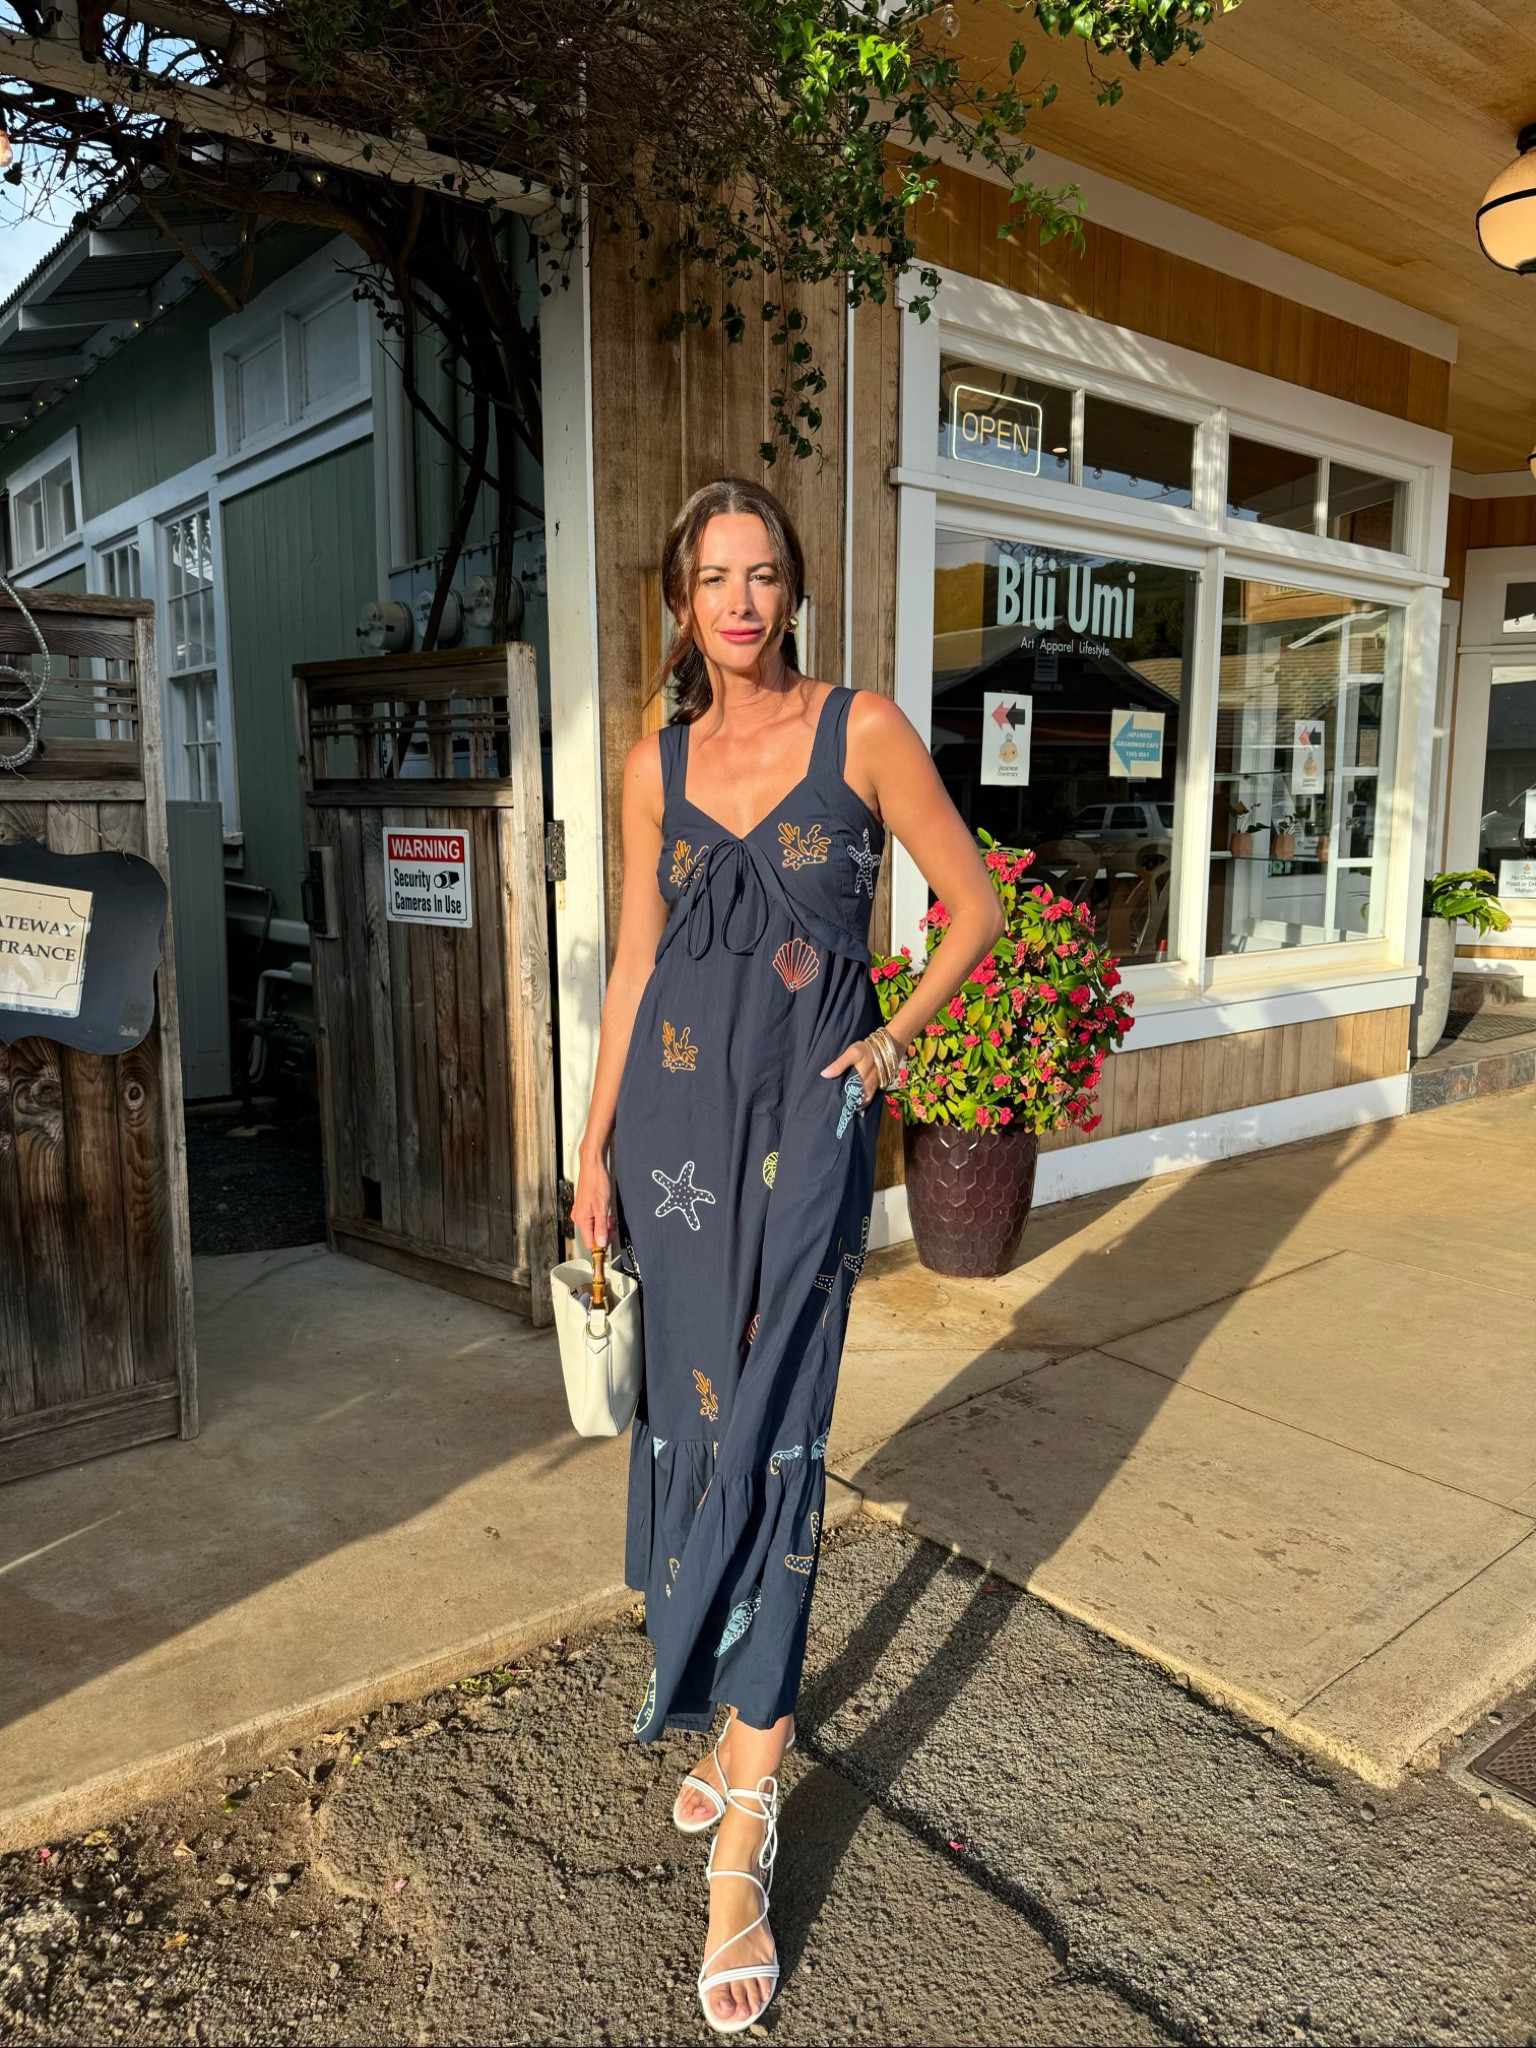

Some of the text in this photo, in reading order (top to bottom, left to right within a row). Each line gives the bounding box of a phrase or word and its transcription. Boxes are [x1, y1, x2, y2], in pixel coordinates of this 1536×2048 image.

[962, 411, 1029, 454] OPEN
[997, 554, 1136, 639] Blü Umi
[1020, 636, 1110, 659] Art Apparel Lifestyle
[1127, 731, 1153, 739] JAPANESE
[391, 838, 460, 859] WARNING
[394, 867, 431, 892] Security
[395, 891, 462, 914] Cameras In Use
